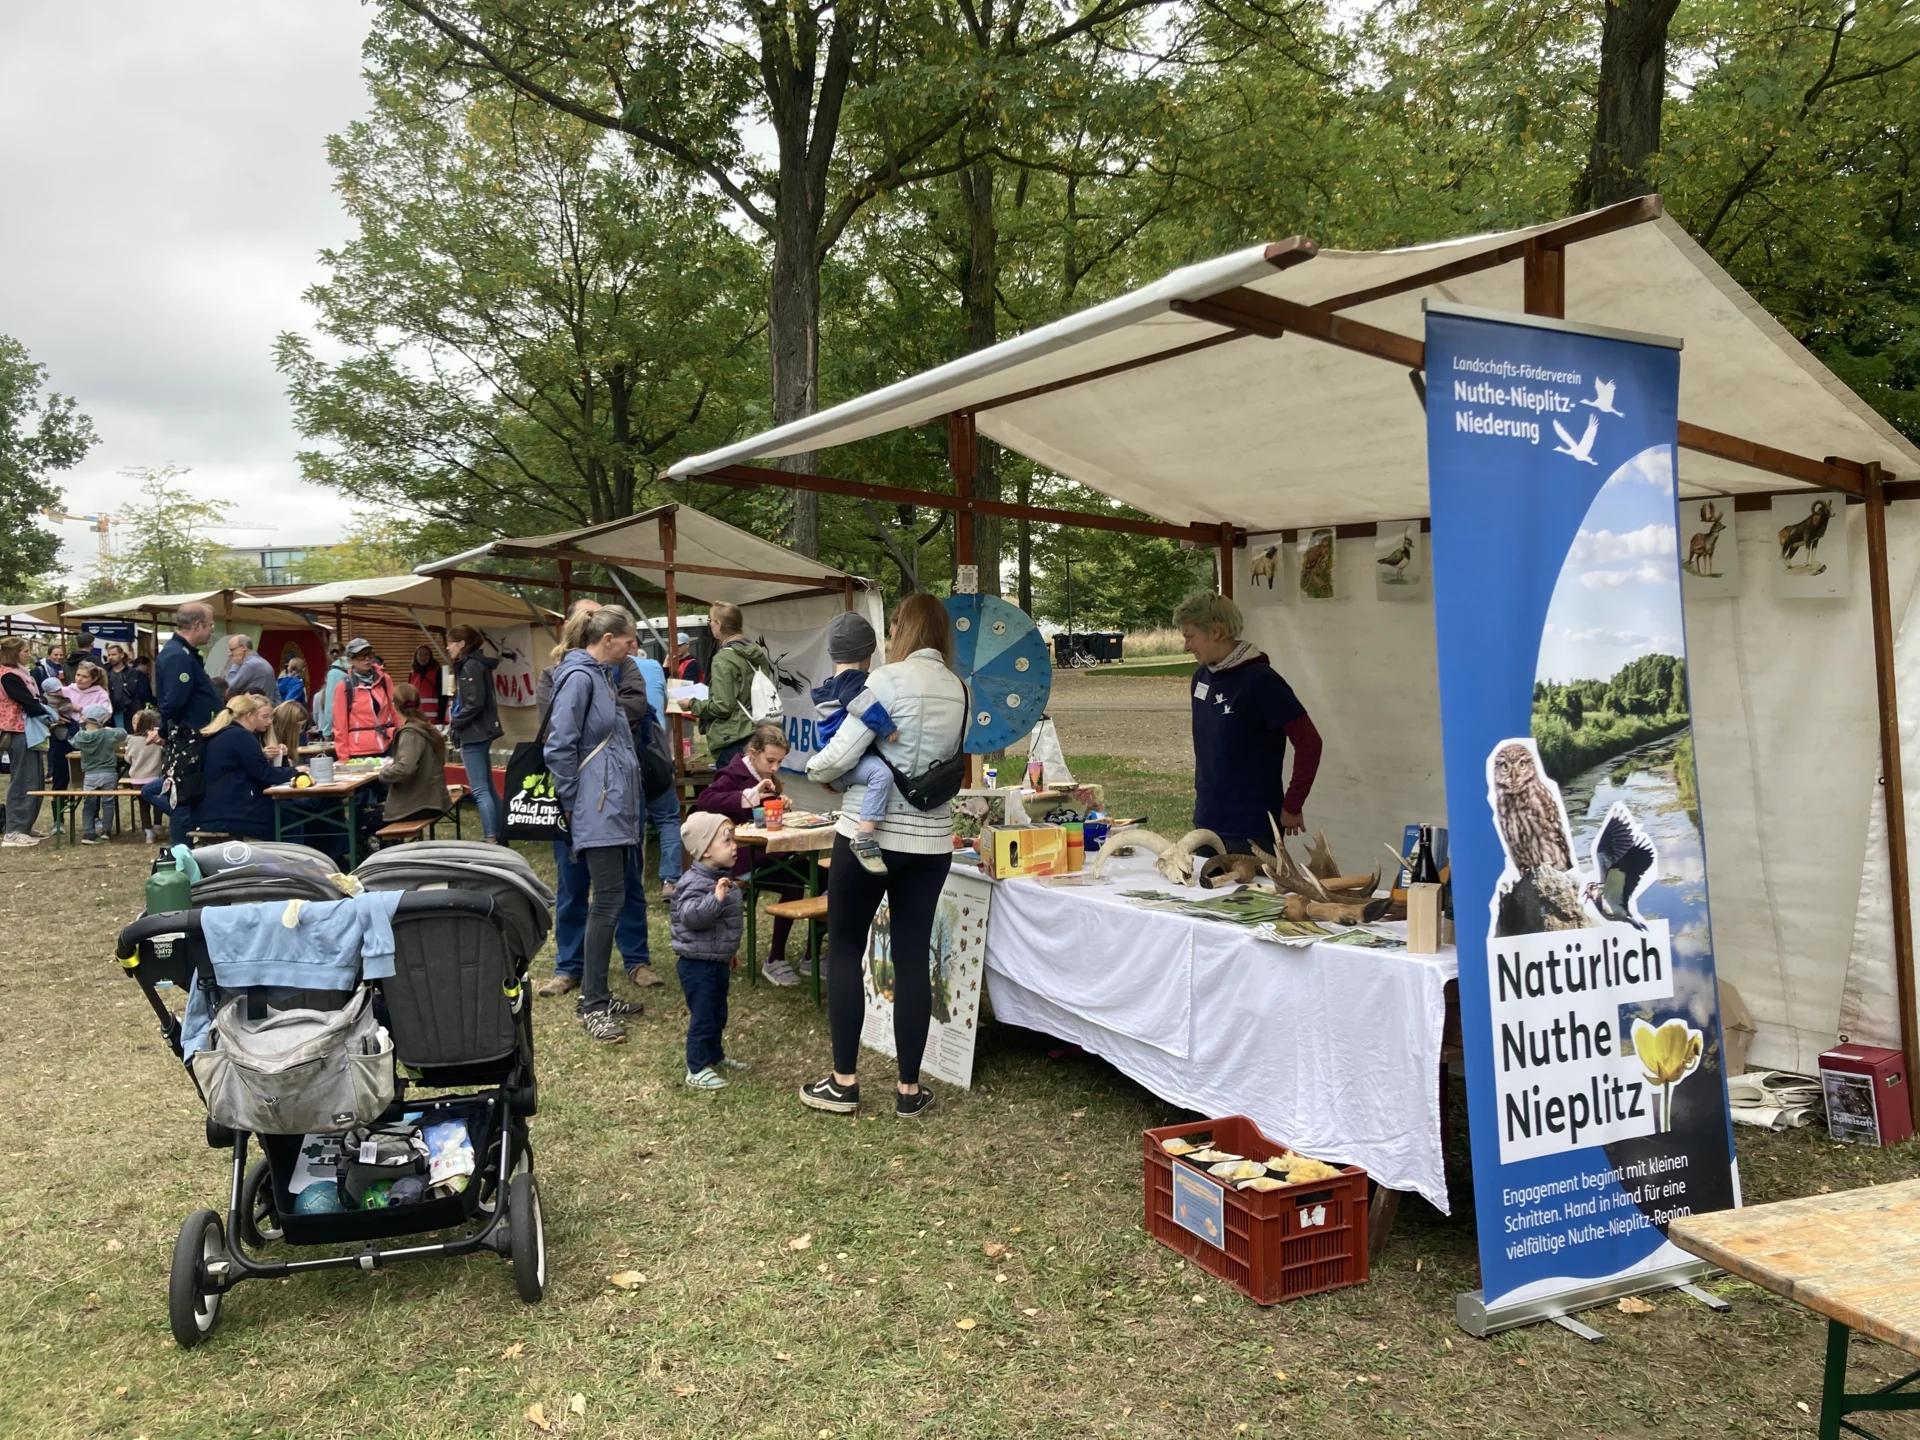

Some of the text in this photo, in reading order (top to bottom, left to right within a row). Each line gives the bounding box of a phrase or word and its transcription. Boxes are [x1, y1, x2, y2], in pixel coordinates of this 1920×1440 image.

[1453, 355, 1582, 385] Landschafts-Förderverein
[1454, 379, 1576, 415] Nuthe-Nieplitz-
[1455, 410, 1540, 445] Niederung
[509, 800, 539, 814] Wald
[1497, 936, 1662, 1002] Natürlich
[1500, 1010, 1612, 1072] Nuthe
[1505, 1073, 1646, 1145] Nieplitz
[1832, 1114, 1873, 1127] Apfelsaft
[1503, 1154, 1688, 1207] Engagement beginnt mit kleinen
[1504, 1179, 1686, 1233] Schritten. Hand in Hand für eine
[1506, 1232, 1566, 1260] vielfältige
